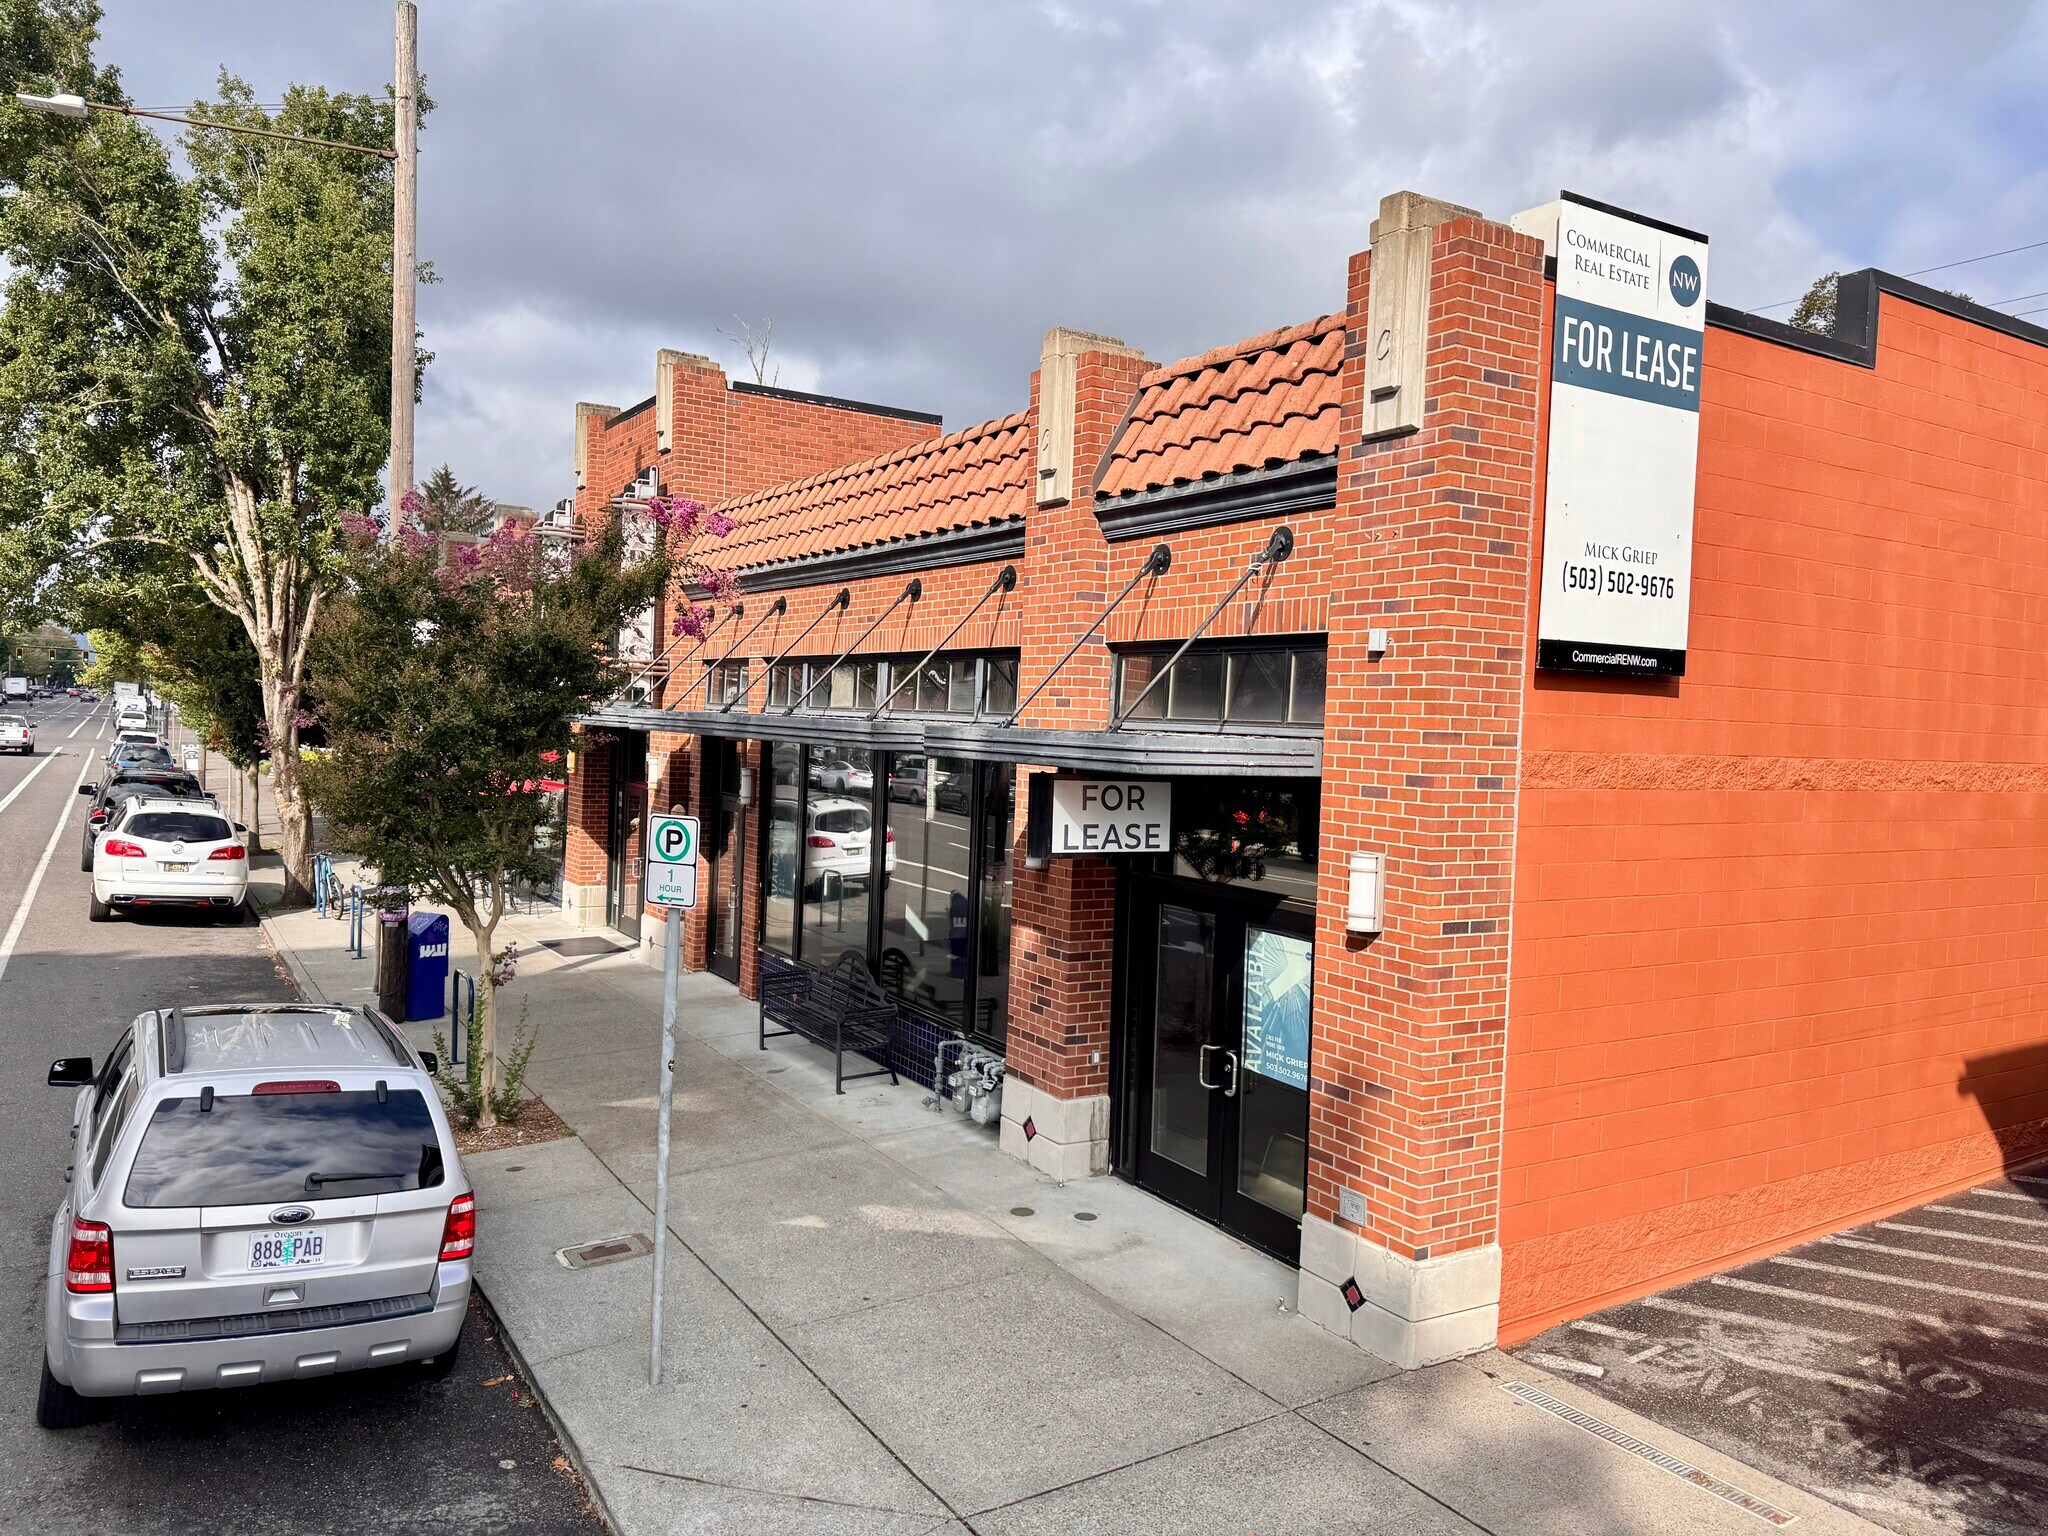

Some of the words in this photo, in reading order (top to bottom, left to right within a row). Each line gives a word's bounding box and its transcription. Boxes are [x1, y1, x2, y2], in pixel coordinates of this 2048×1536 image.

[1566, 229, 1651, 268] COMMERCIAL
[1575, 254, 1605, 277] REAL
[1609, 264, 1650, 290] ESTATE
[1672, 272, 1698, 292] NW
[1562, 316, 1614, 374] FOR
[1621, 331, 1697, 392] LEASE
[1585, 542, 1618, 561] MICK
[1622, 547, 1658, 565] GRIEP
[1562, 561, 1603, 596] (503)
[1608, 571, 1674, 599] 502-9676
[1572, 650, 1657, 668] CommercialRENW.com
[1082, 785, 1145, 811] FOR
[666, 829, 682, 853] P
[1063, 824, 1161, 850] LEASE
[668, 869, 674, 882] 1
[659, 884, 682, 893] HOUR
[1266, 1050, 1285, 1062] MICK
[1286, 1057, 1308, 1069] GRIEP
[1266, 1062, 1308, 1083] 503.502.9676
[274, 1230, 302, 1239] Oregon
[253, 1240, 283, 1261] 888
[293, 1236, 323, 1258] PAB
